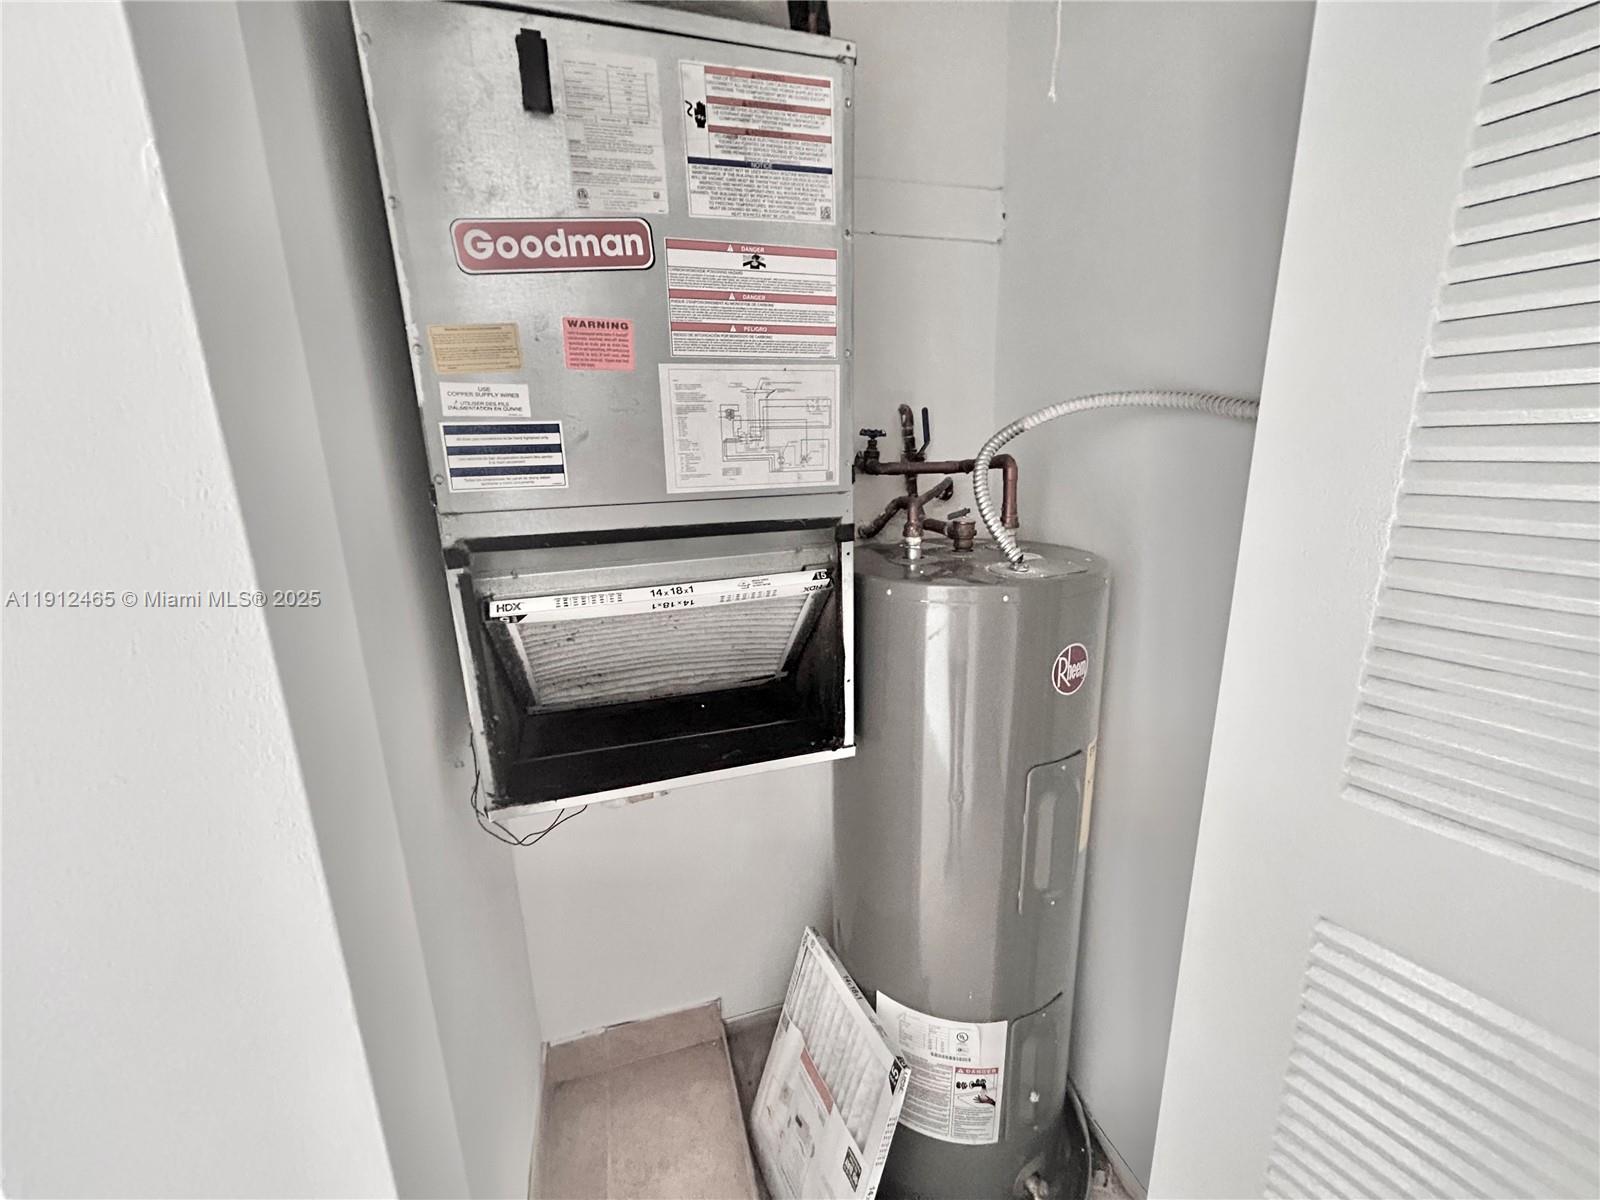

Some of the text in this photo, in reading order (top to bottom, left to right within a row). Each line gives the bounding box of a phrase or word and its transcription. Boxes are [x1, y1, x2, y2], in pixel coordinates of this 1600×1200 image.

[750, 161, 773, 169] NOTICE
[463, 228, 644, 260] Goodman
[567, 320, 629, 330] WARNING
[496, 603, 522, 613] HDX
[1057, 646, 1087, 688] Rheem
